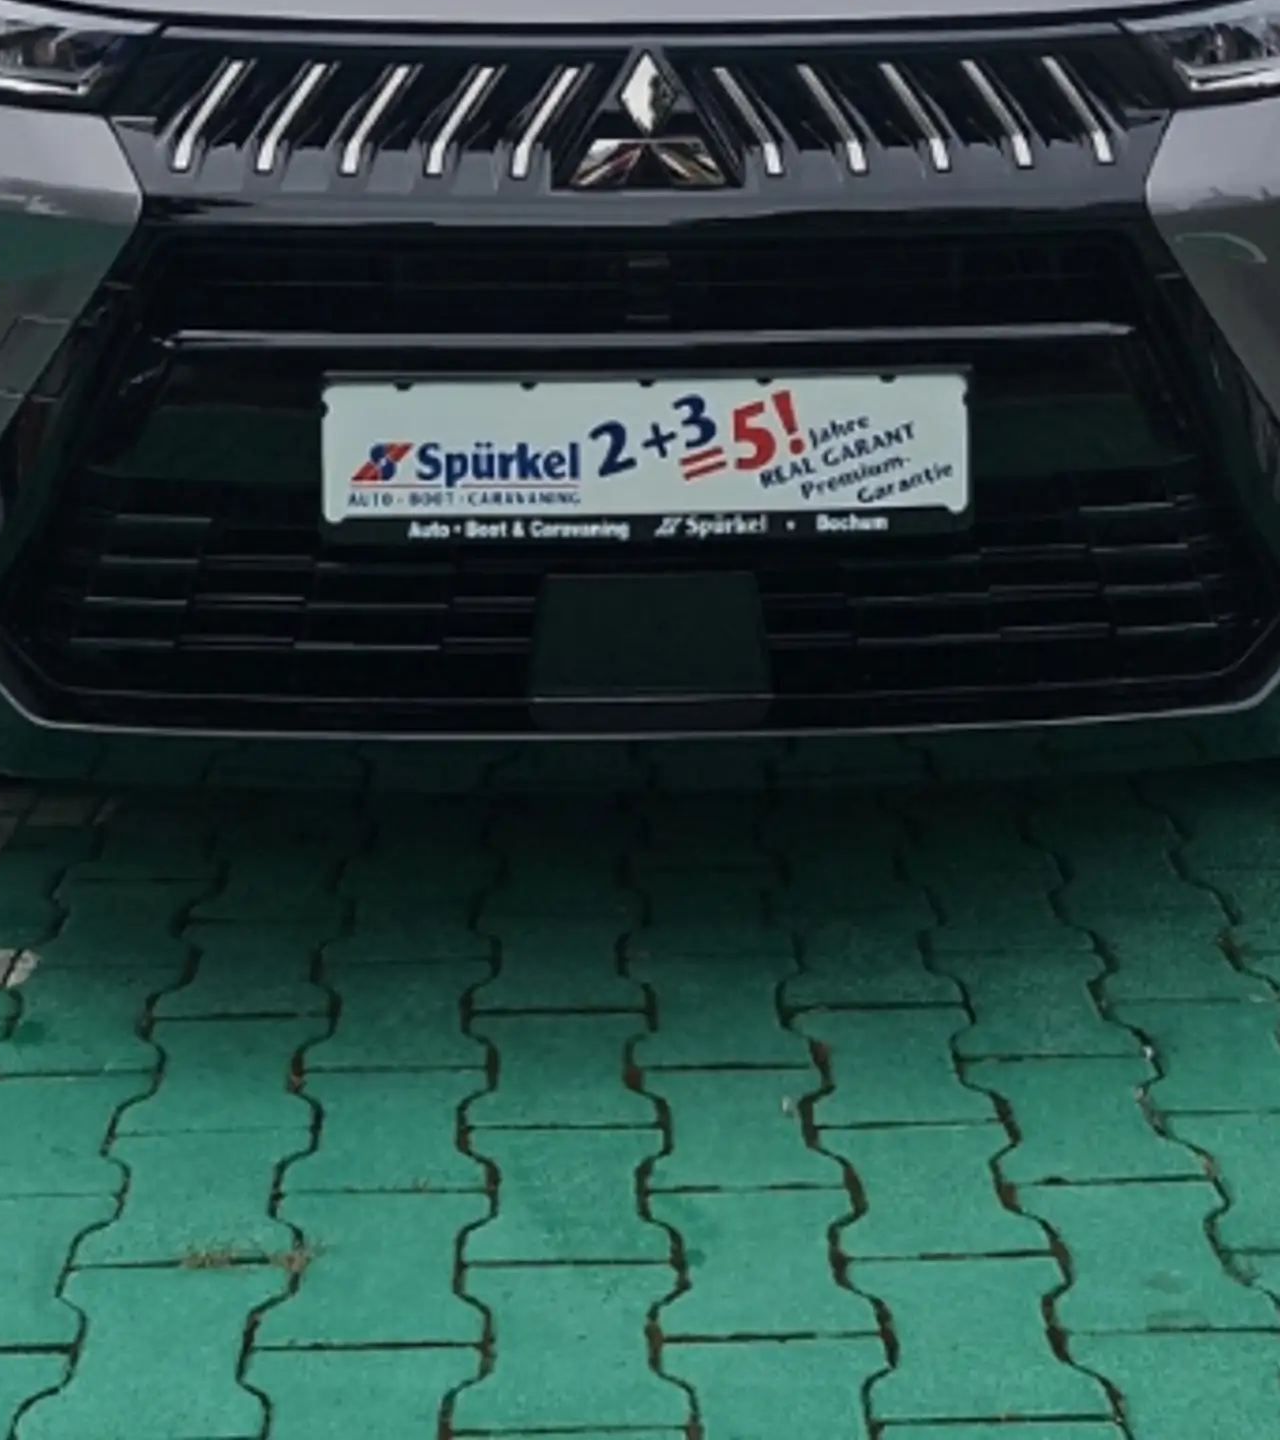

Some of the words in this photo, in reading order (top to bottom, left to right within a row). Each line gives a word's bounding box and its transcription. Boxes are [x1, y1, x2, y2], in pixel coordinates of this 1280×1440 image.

[808, 416, 870, 449] Jahre
[415, 441, 581, 488] Spürkel
[759, 457, 816, 489] REAL
[821, 421, 915, 467] GARANT
[348, 491, 393, 507] AUTO
[409, 491, 455, 507] BOOT
[467, 490, 581, 507] CARAVANING
[856, 463, 953, 504] Garantie
[407, 521, 451, 539] Auto
[464, 520, 508, 538] Boot
[530, 520, 630, 540] Caravaning
[685, 513, 768, 538] Spürkel
[816, 512, 889, 532] Bochum
